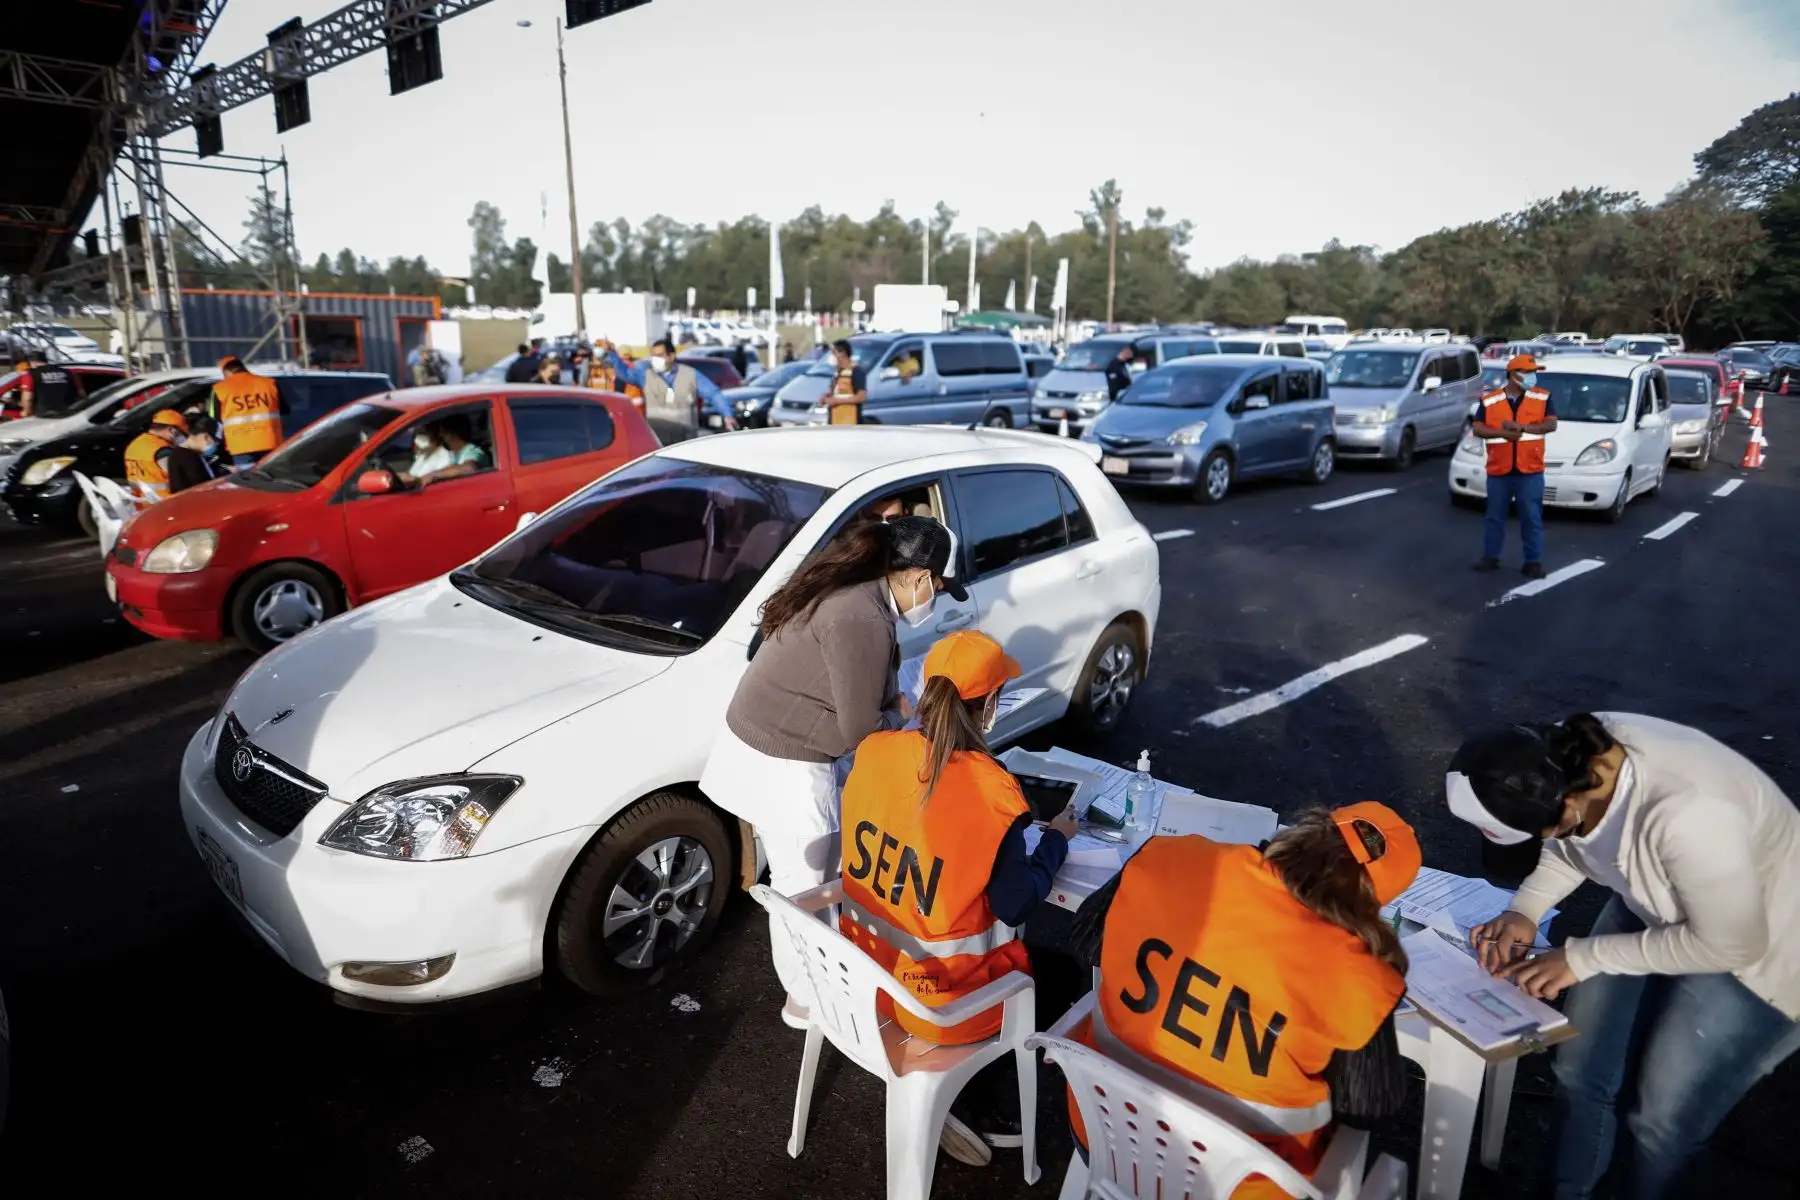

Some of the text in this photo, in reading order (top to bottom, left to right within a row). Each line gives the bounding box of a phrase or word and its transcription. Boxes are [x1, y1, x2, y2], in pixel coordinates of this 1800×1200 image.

[232, 391, 270, 412] SEN
[847, 820, 945, 917] SEN
[1119, 937, 1288, 1078] SEN
